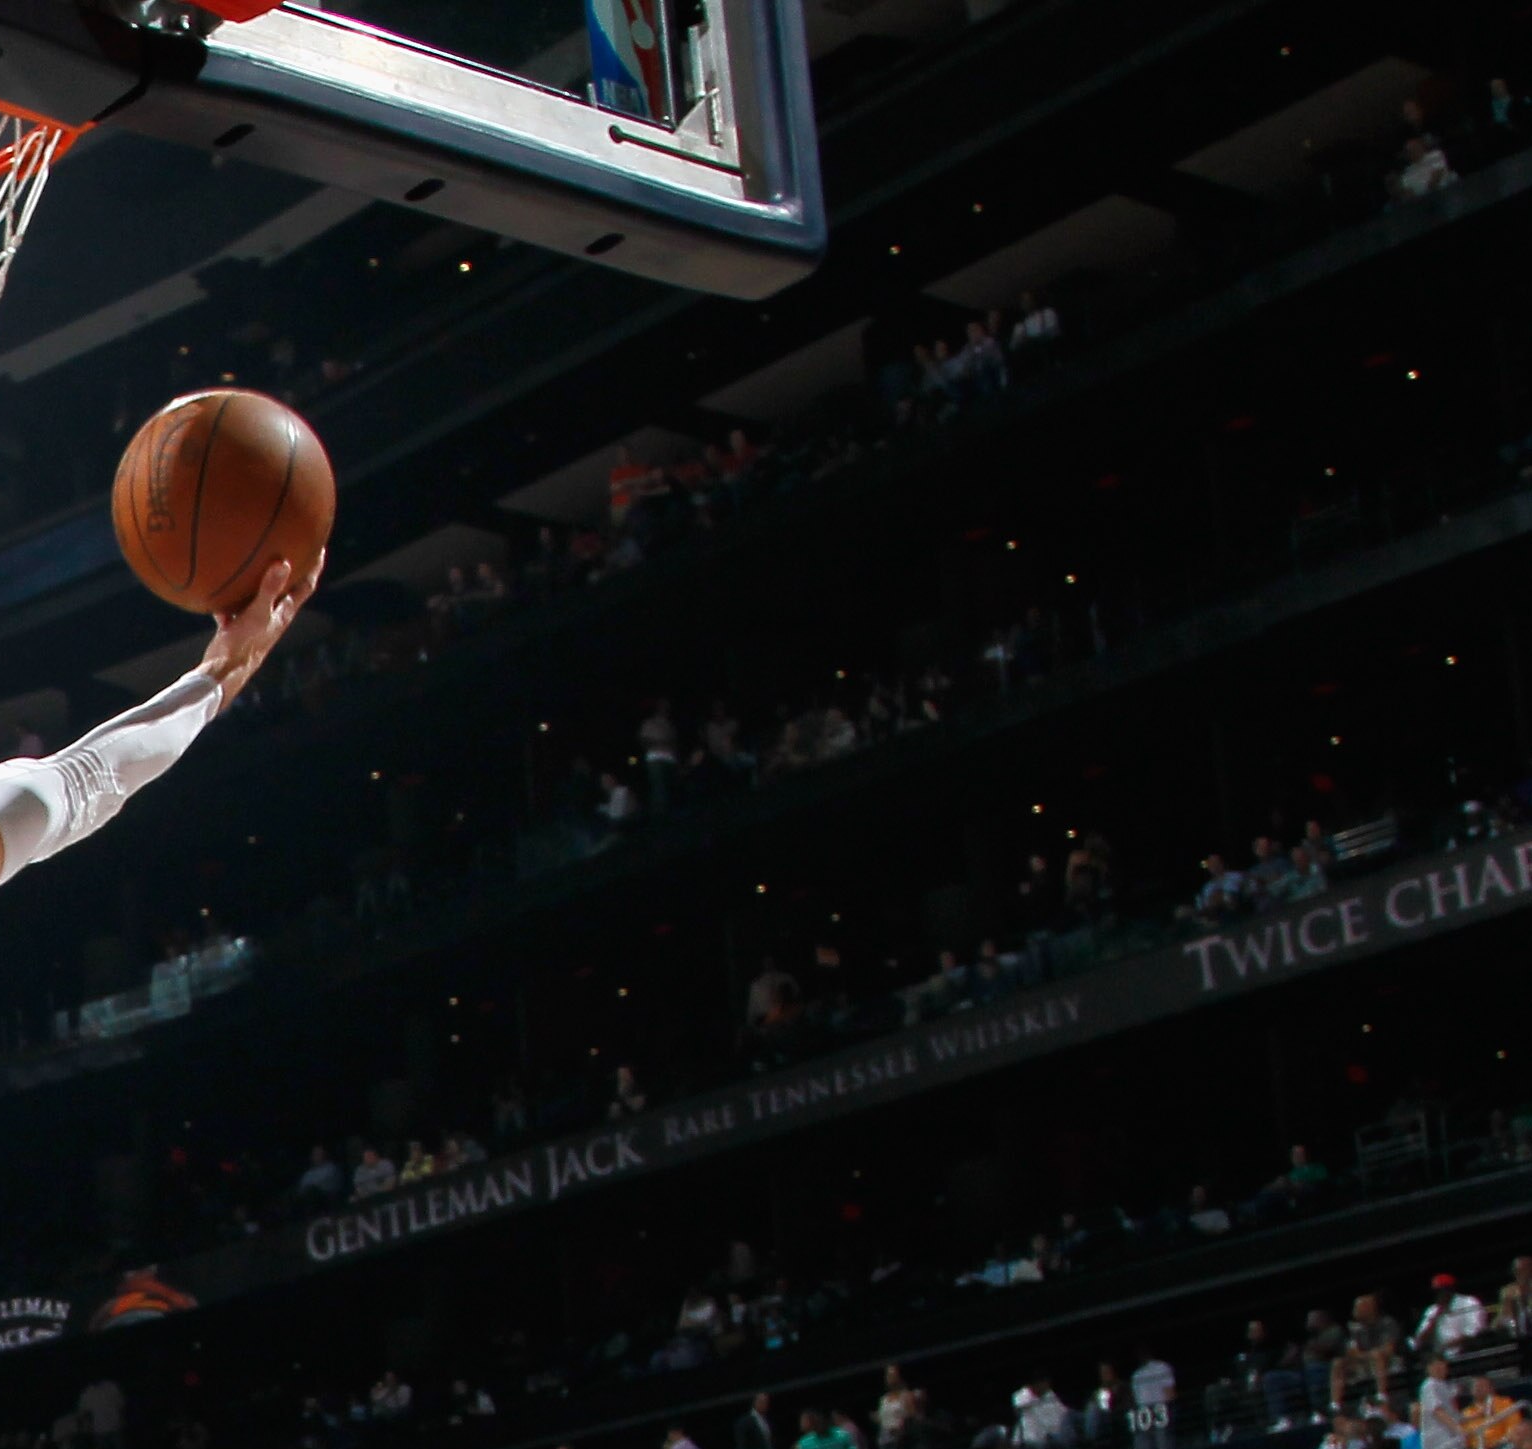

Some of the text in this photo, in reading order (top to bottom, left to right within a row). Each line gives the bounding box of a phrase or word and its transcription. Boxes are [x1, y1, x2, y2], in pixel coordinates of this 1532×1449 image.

[1184, 896, 1372, 992] TWICE
[305, 997, 1083, 1262] GENTLEMAN JACK RARE TENNESSEE WHISKEY
[1126, 1402, 1169, 1432] 103
